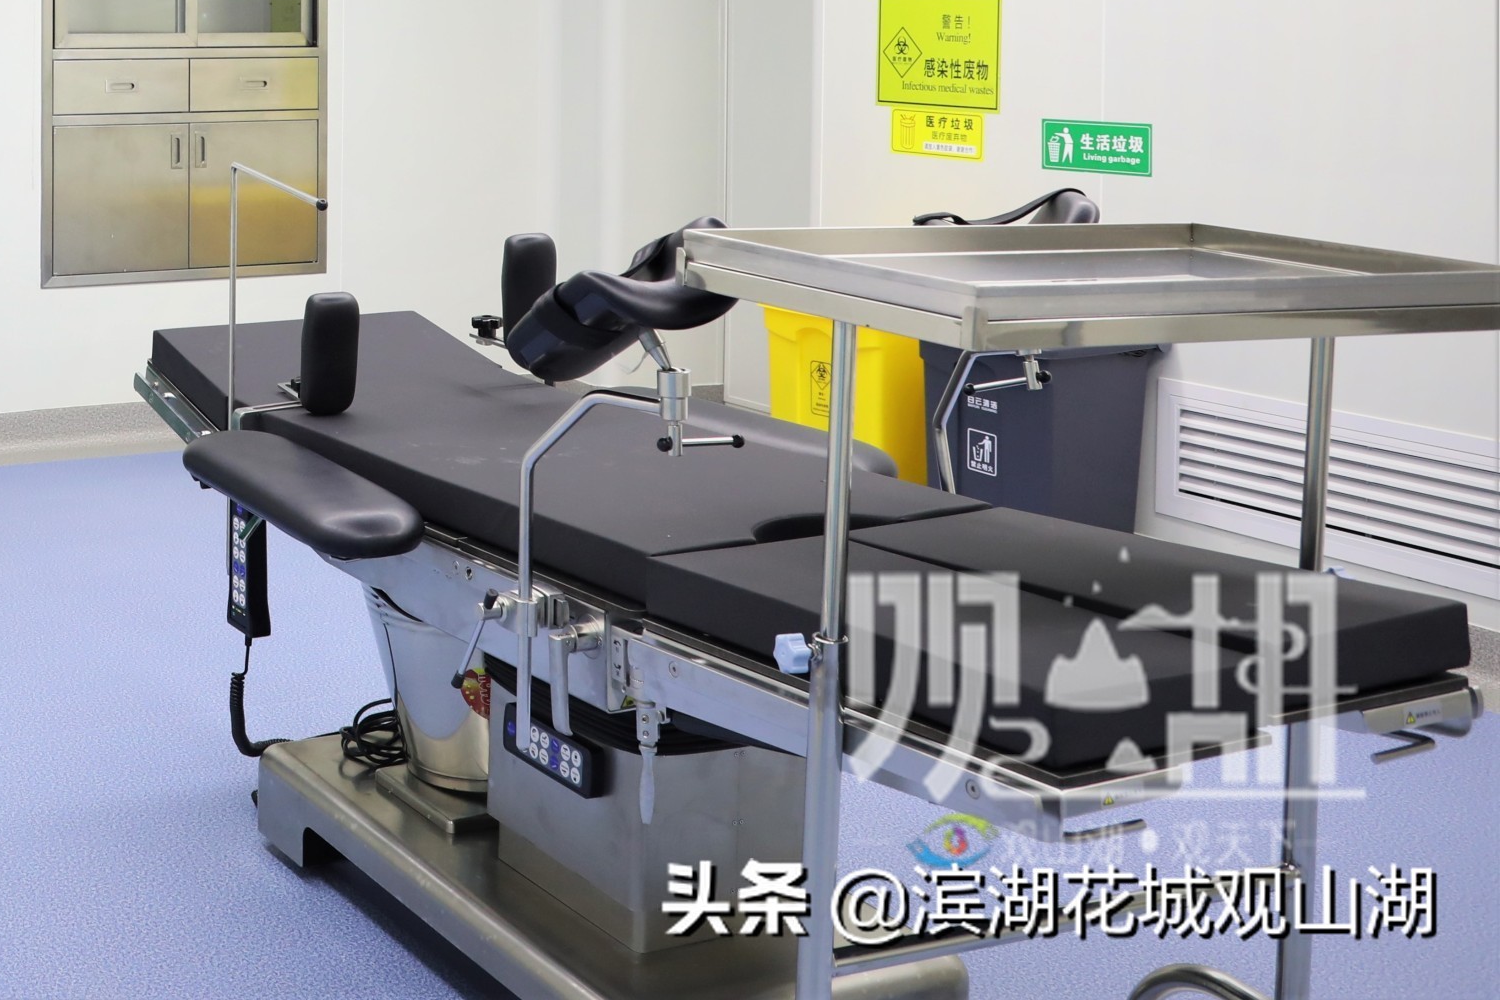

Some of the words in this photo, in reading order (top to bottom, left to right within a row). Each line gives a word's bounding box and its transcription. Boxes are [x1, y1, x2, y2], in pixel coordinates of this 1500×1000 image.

[936, 31, 972, 45] Warning!
[924, 58, 989, 81] 感染性废物
[902, 81, 937, 92] Infectious
[938, 83, 967, 95] medical
[968, 86, 995, 96] wastes
[925, 115, 974, 131] 医疗垃圾
[1080, 133, 1144, 154] 生活垃圾
[1083, 152, 1108, 164] Living
[1108, 155, 1141, 166] garbage
